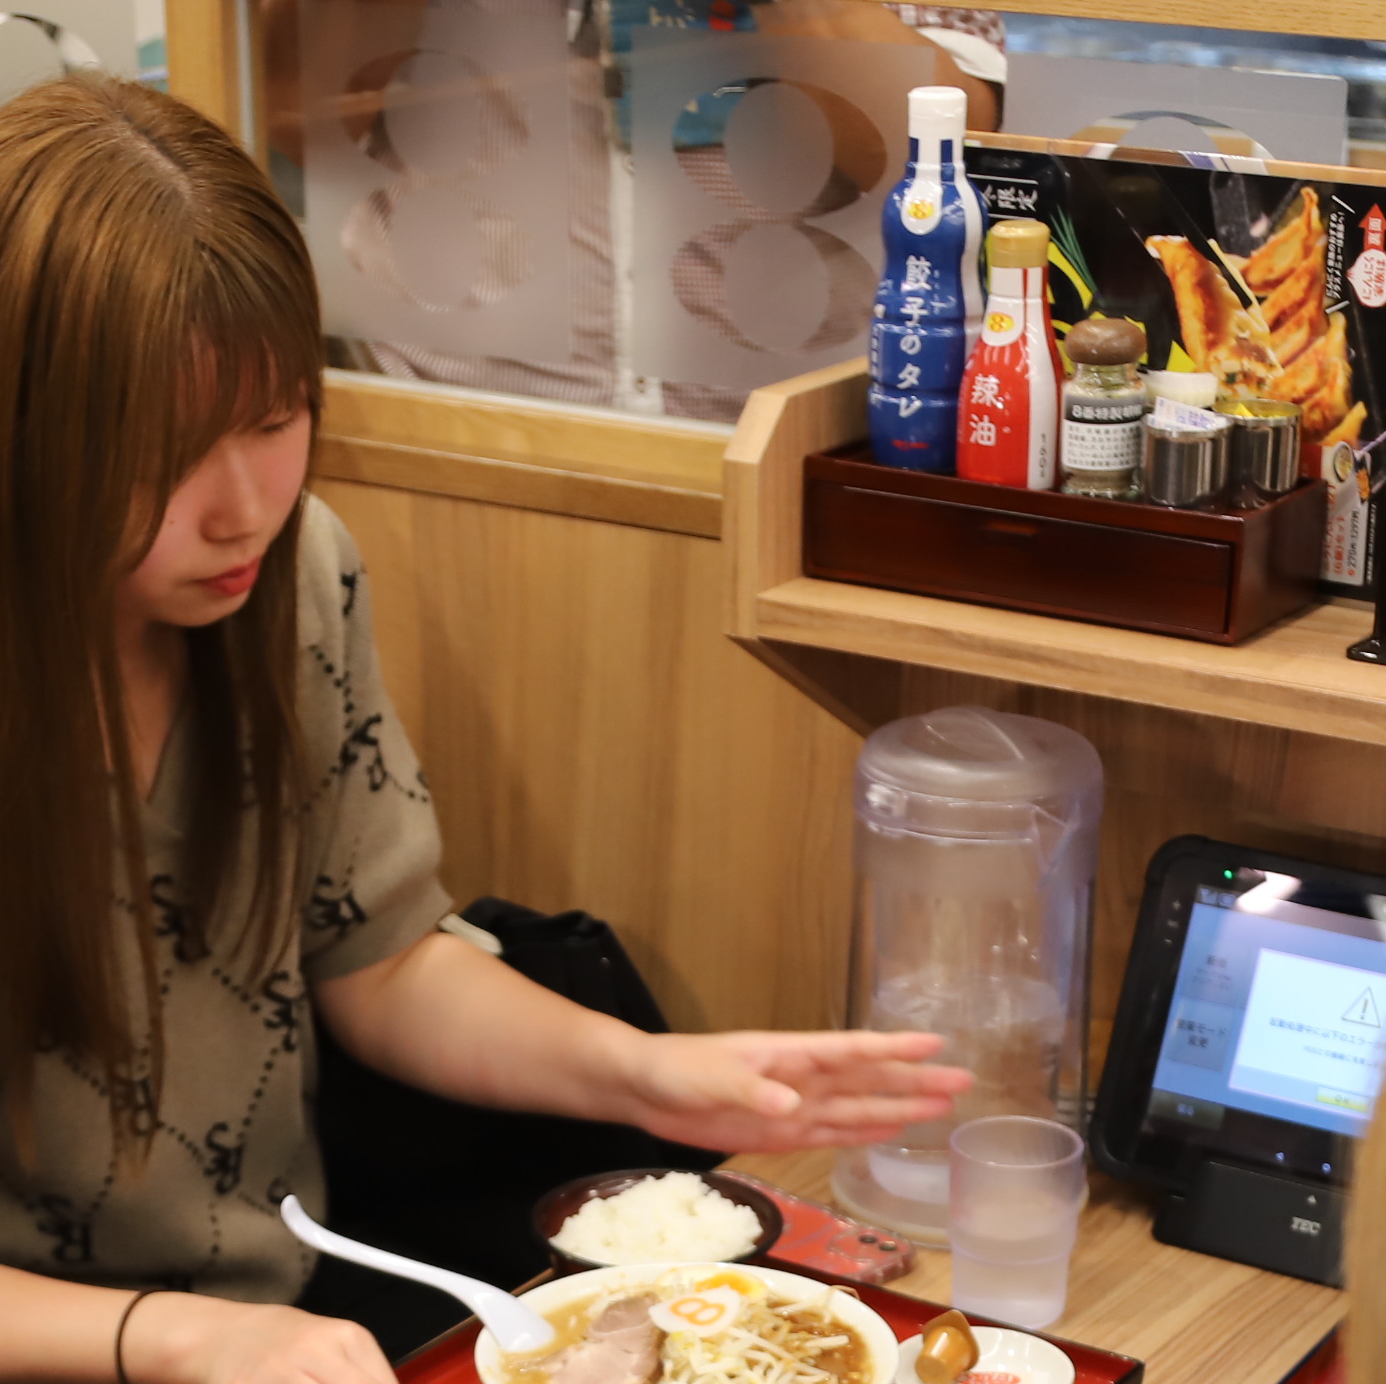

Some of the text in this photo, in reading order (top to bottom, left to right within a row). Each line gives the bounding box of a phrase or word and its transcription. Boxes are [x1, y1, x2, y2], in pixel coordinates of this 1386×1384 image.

[1363, 256, 1375, 300] にんにく
[898, 255, 932, 418] 餃子のタレ
[970, 373, 1005, 446] 辣油
